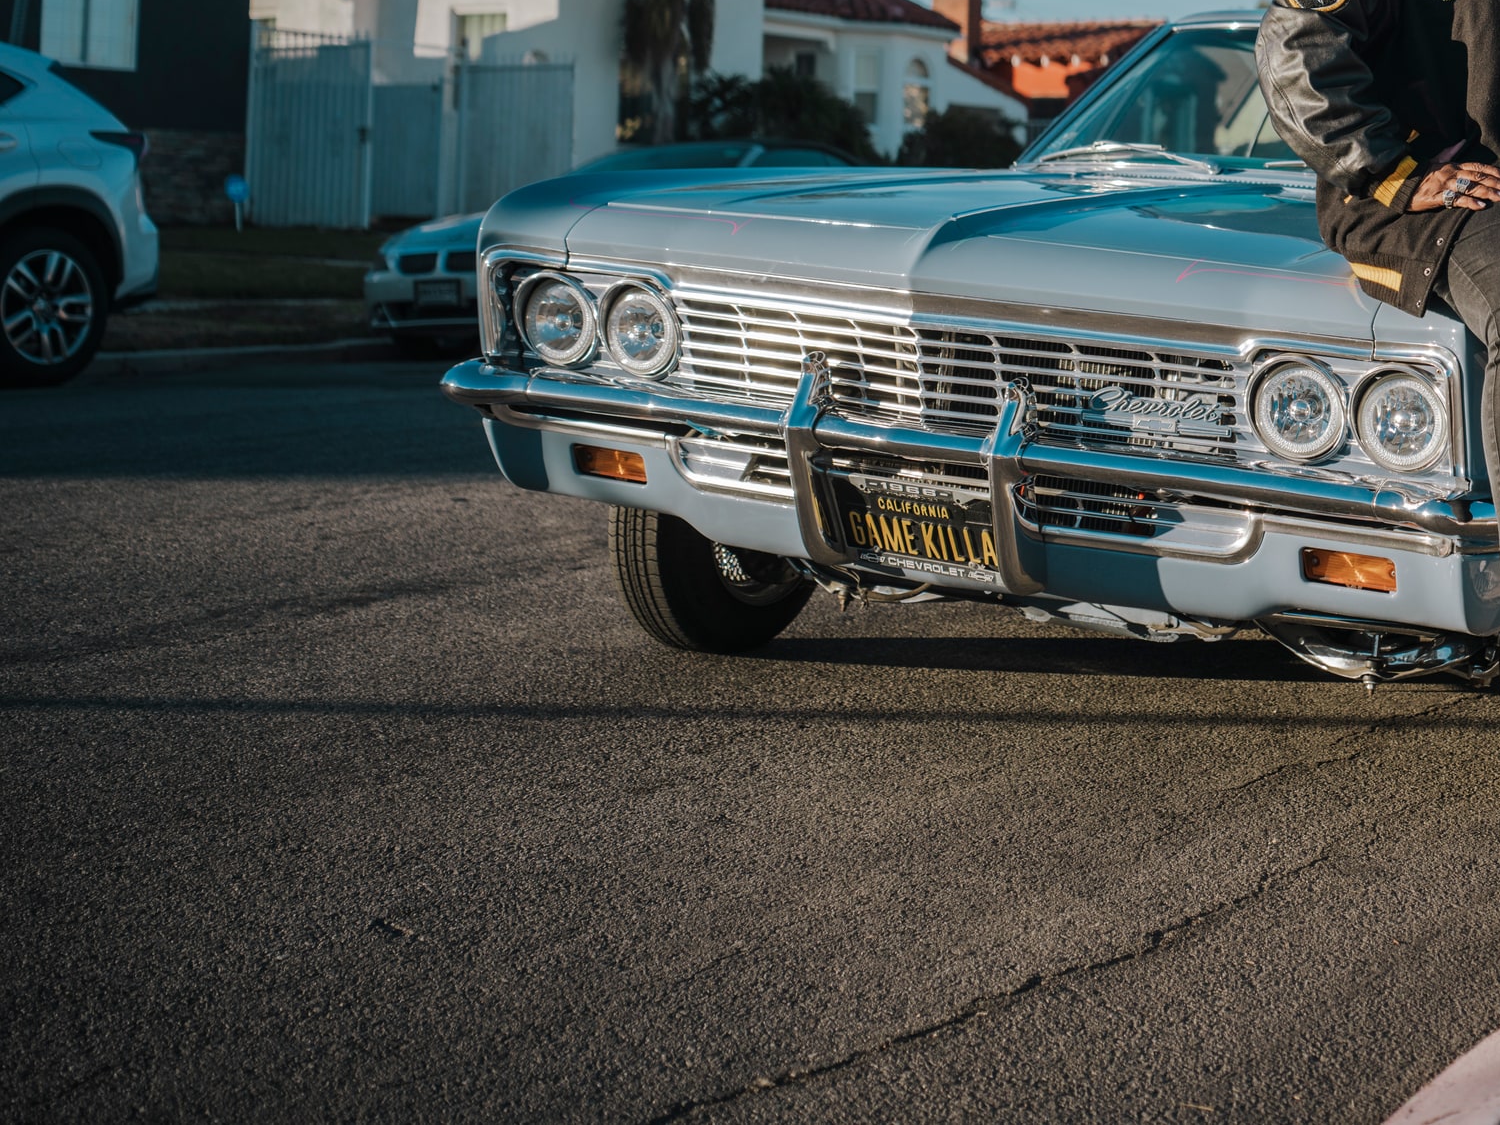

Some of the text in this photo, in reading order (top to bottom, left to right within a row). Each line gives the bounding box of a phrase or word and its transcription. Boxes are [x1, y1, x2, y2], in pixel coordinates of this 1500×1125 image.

[1089, 386, 1222, 422] Chevrolet
[877, 496, 950, 520] CALIFORNIA
[887, 556, 966, 578] CHEVROLET
